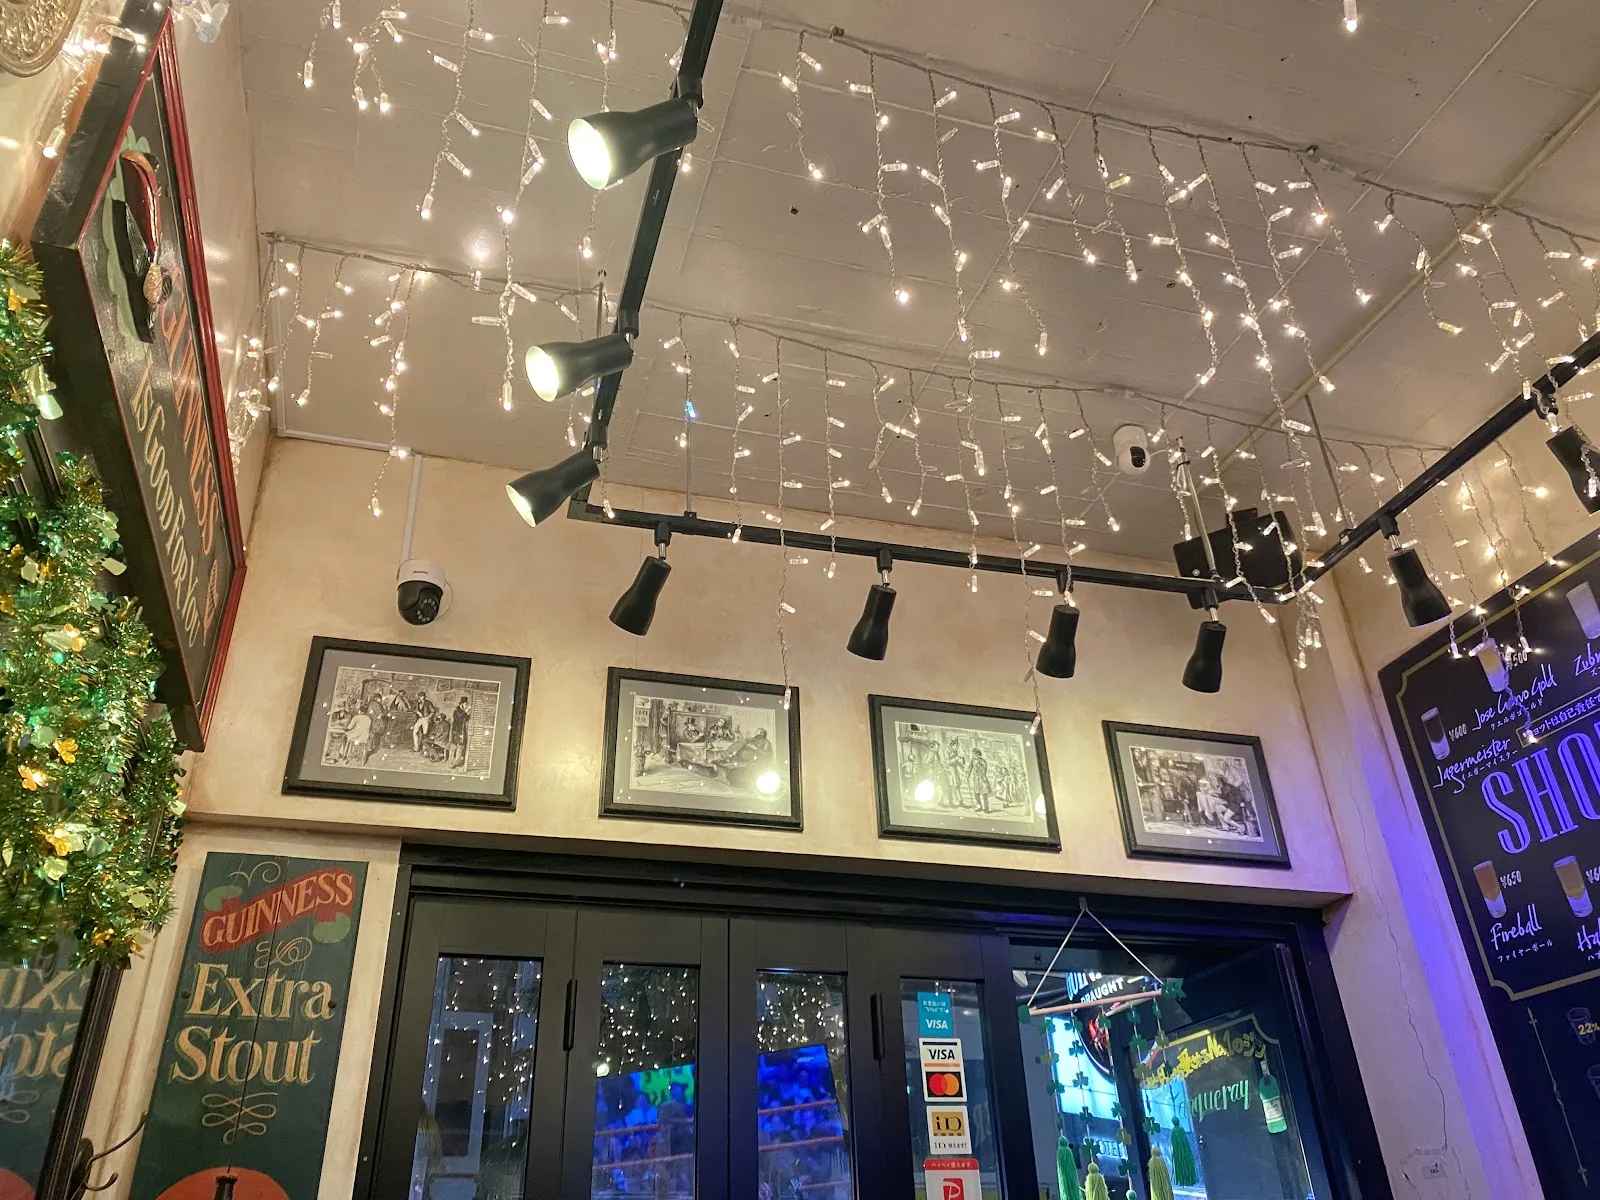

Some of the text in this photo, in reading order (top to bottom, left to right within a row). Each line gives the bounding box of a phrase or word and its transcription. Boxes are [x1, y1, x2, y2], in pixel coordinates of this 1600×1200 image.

[160, 263, 219, 556] GUINNESS
[144, 404, 176, 532] GOOD
[166, 496, 190, 611] FOR
[182, 554, 201, 648] YOU
[1472, 663, 1557, 731] Jose Cuvo Gold
[1532, 693, 1600, 736] ョットは自己責任
[1481, 721, 1600, 854] SHO
[1500, 870, 1522, 889] ¥650
[202, 873, 354, 947] GUINNESS
[1490, 903, 1543, 951] Fireball
[1577, 917, 1600, 952] Ha
[186, 962, 336, 1021] Extra
[1080, 976, 1124, 1004] DRAUGHT
[925, 1018, 949, 1030] VISA
[171, 1025, 322, 1085] Stout
[927, 1048, 956, 1060] VISA
[935, 1116, 962, 1131] iD
